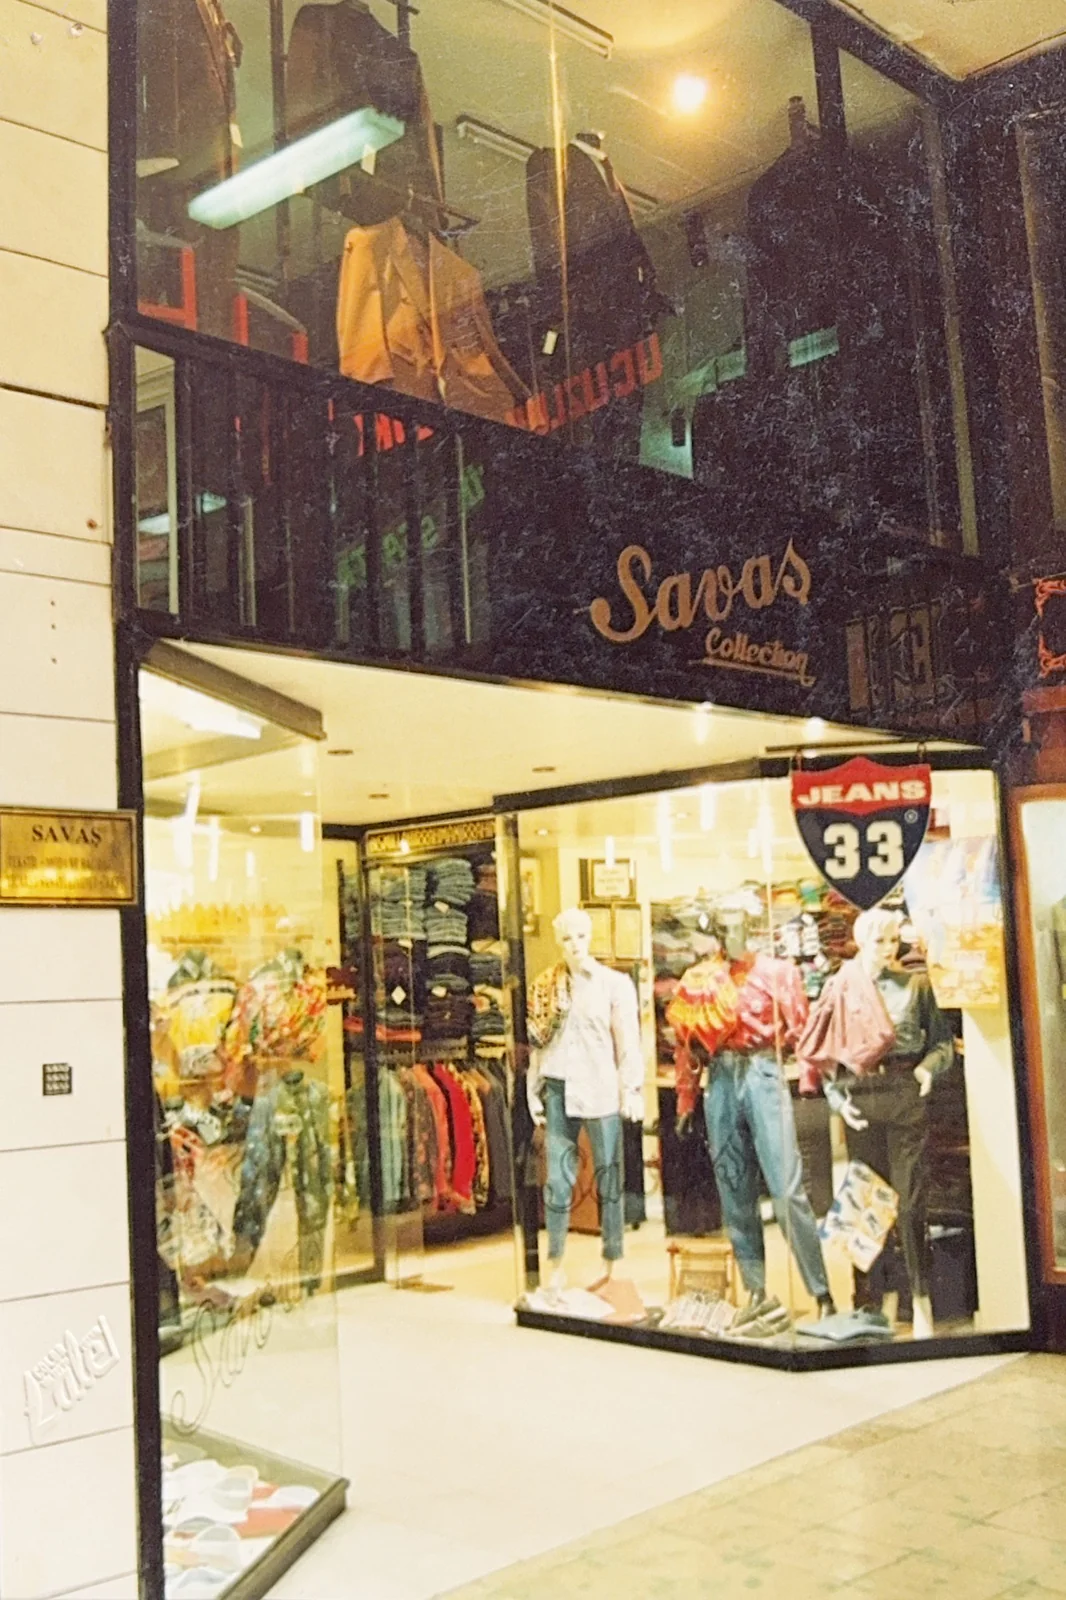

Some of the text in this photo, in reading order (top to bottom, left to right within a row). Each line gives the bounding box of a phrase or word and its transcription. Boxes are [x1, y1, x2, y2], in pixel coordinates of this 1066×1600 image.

[705, 627, 816, 687] Collection
[797, 779, 927, 806] JEANS
[823, 820, 905, 880] 33
